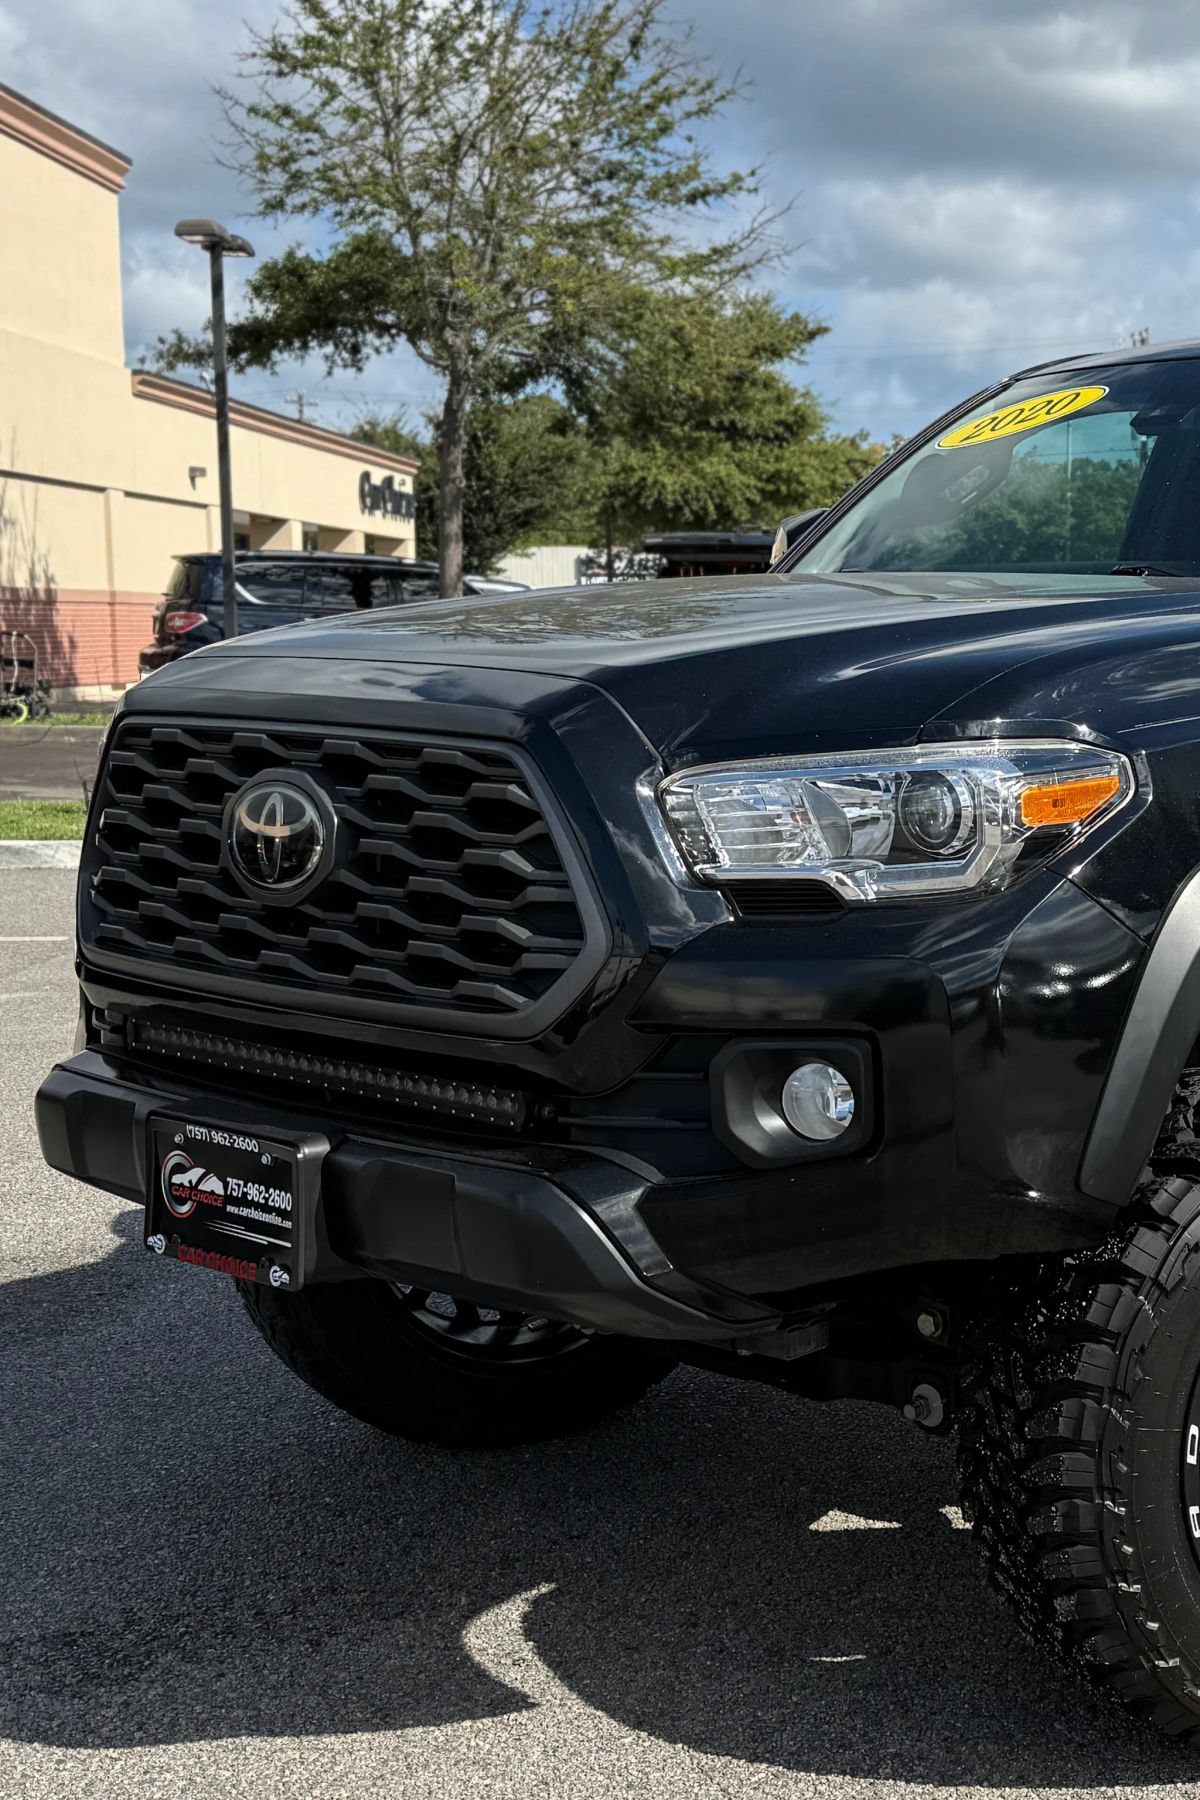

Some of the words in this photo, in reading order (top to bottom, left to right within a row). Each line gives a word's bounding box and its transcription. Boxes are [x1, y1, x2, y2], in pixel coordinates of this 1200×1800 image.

[958, 391, 1082, 444] 2020
[186, 1124, 210, 1142] (757)
[211, 1131, 259, 1153] 962-2600
[171, 1185, 190, 1198] CAR
[191, 1189, 225, 1207] CHOICE
[226, 1176, 292, 1211] 757-962-2600
[226, 1203, 292, 1229] www.carchoiceonline.com
[178, 1243, 204, 1264] CAR
[207, 1250, 258, 1281] CHOICE
